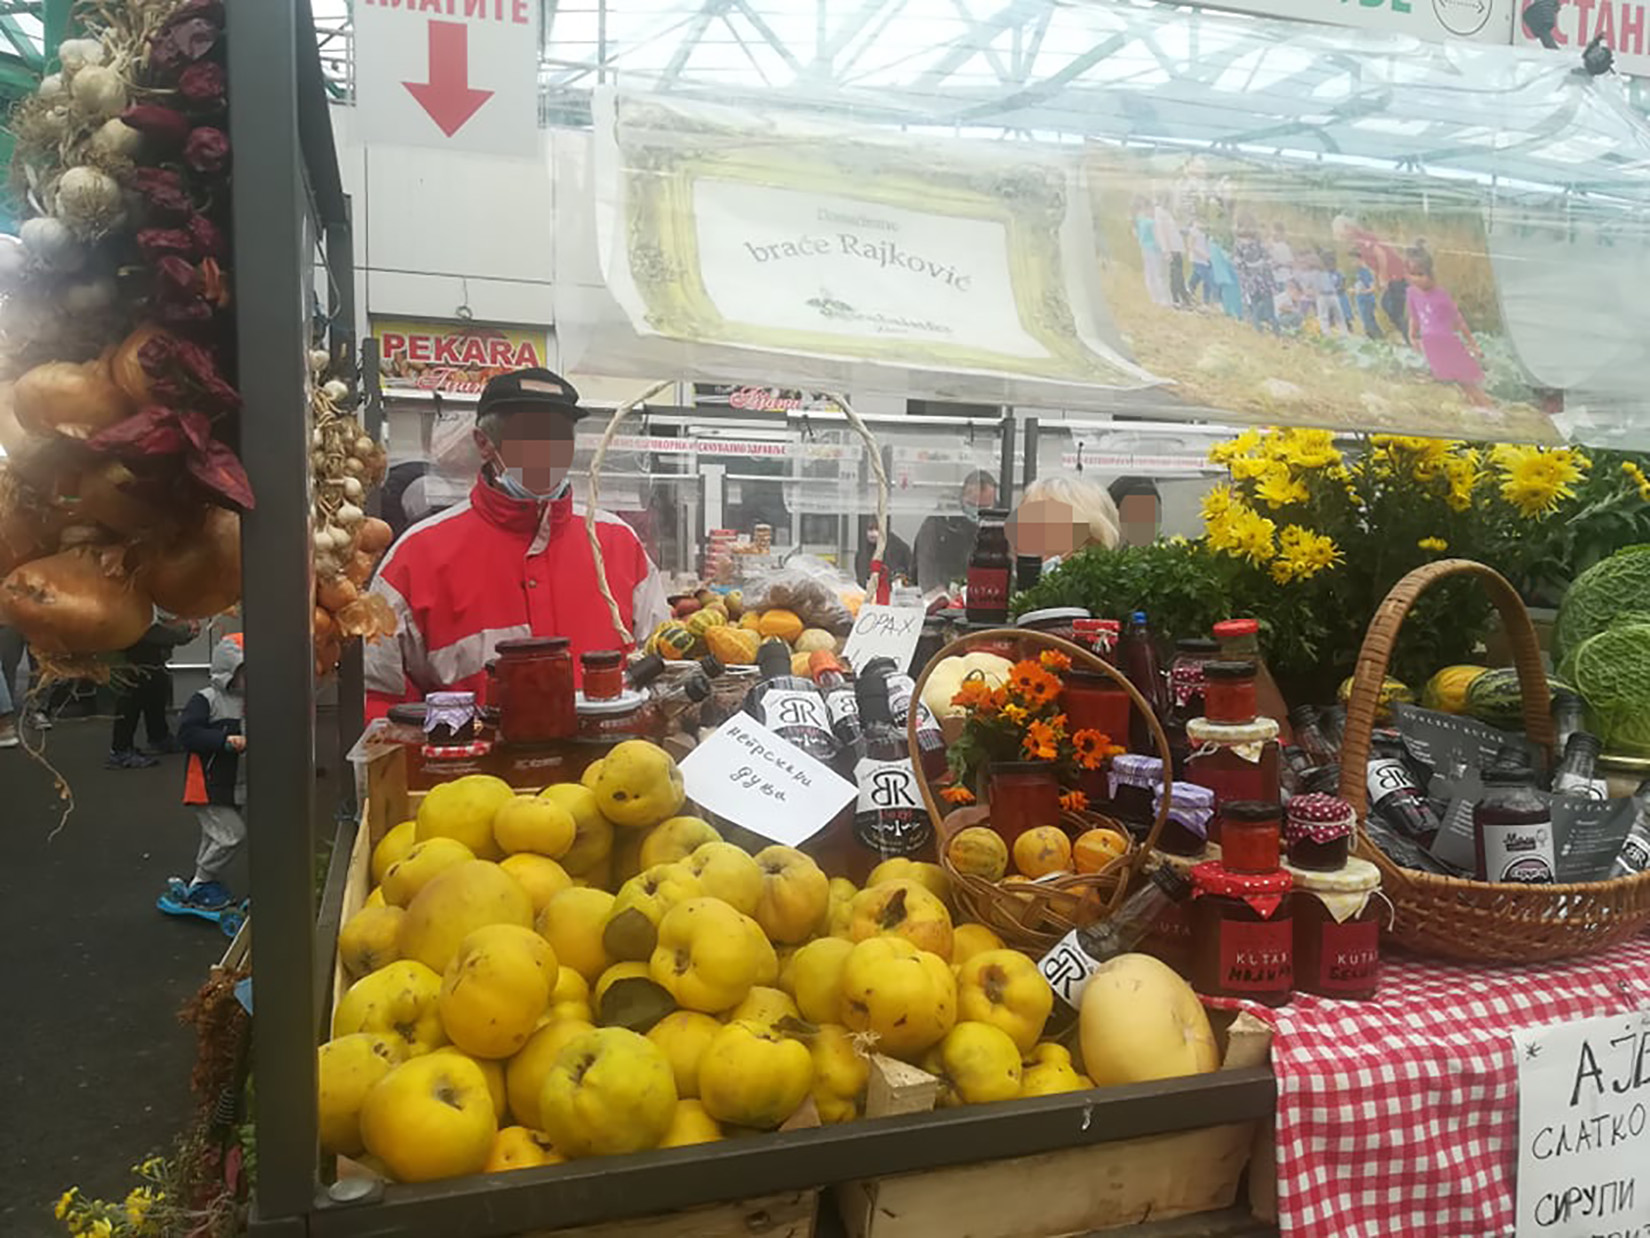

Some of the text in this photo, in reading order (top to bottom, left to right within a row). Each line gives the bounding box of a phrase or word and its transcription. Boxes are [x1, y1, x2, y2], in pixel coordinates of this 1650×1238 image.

[743, 232, 972, 292] braće Rajković
[381, 331, 541, 368] PEKARA
[1532, 1103, 1646, 1160] СЛАТКО
[1534, 1178, 1635, 1227] СИРУПИ
